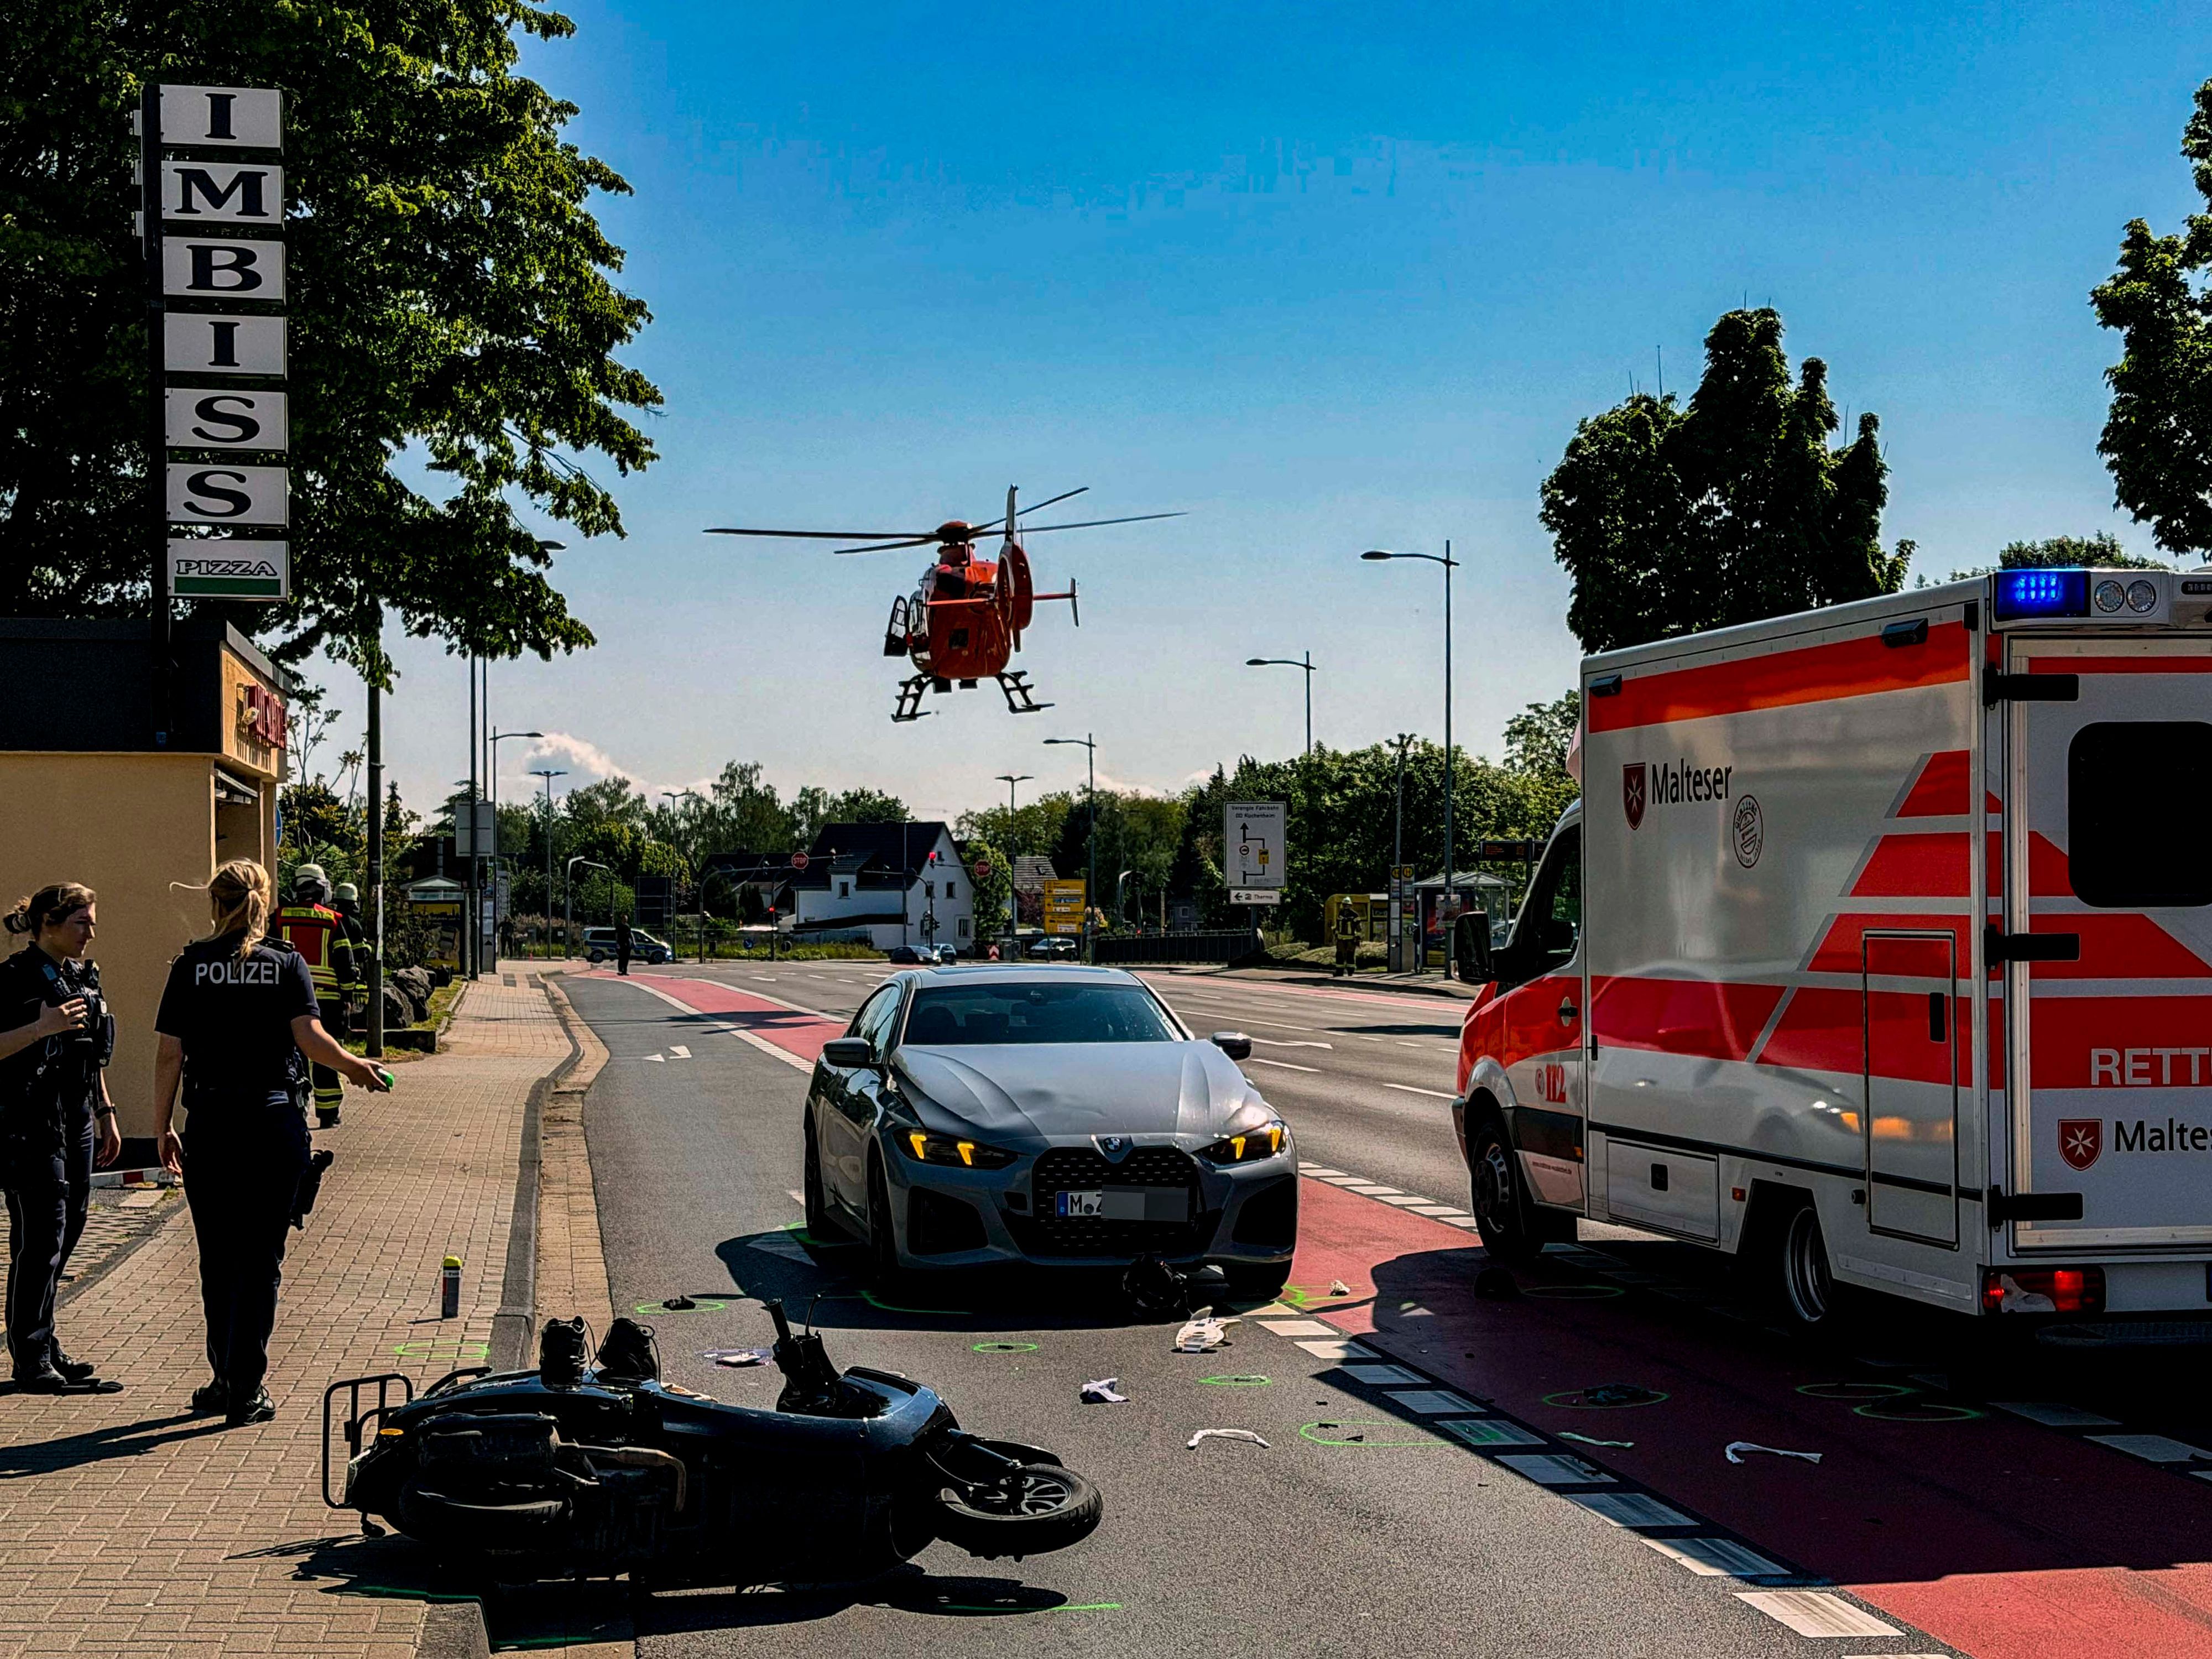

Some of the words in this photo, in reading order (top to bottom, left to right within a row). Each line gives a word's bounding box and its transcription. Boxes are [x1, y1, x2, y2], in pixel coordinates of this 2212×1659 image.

[173, 93, 270, 518] IMBISS
[176, 559, 278, 576] PIZZA
[1652, 758, 1732, 804] Malteser
[195, 961, 279, 985] POLIZEI
[1546, 1063, 1566, 1103] 112
[2091, 1047, 2212, 1086] RETT
[2115, 1118, 2212, 1152] Malte
[1070, 1194, 1082, 1213] M
